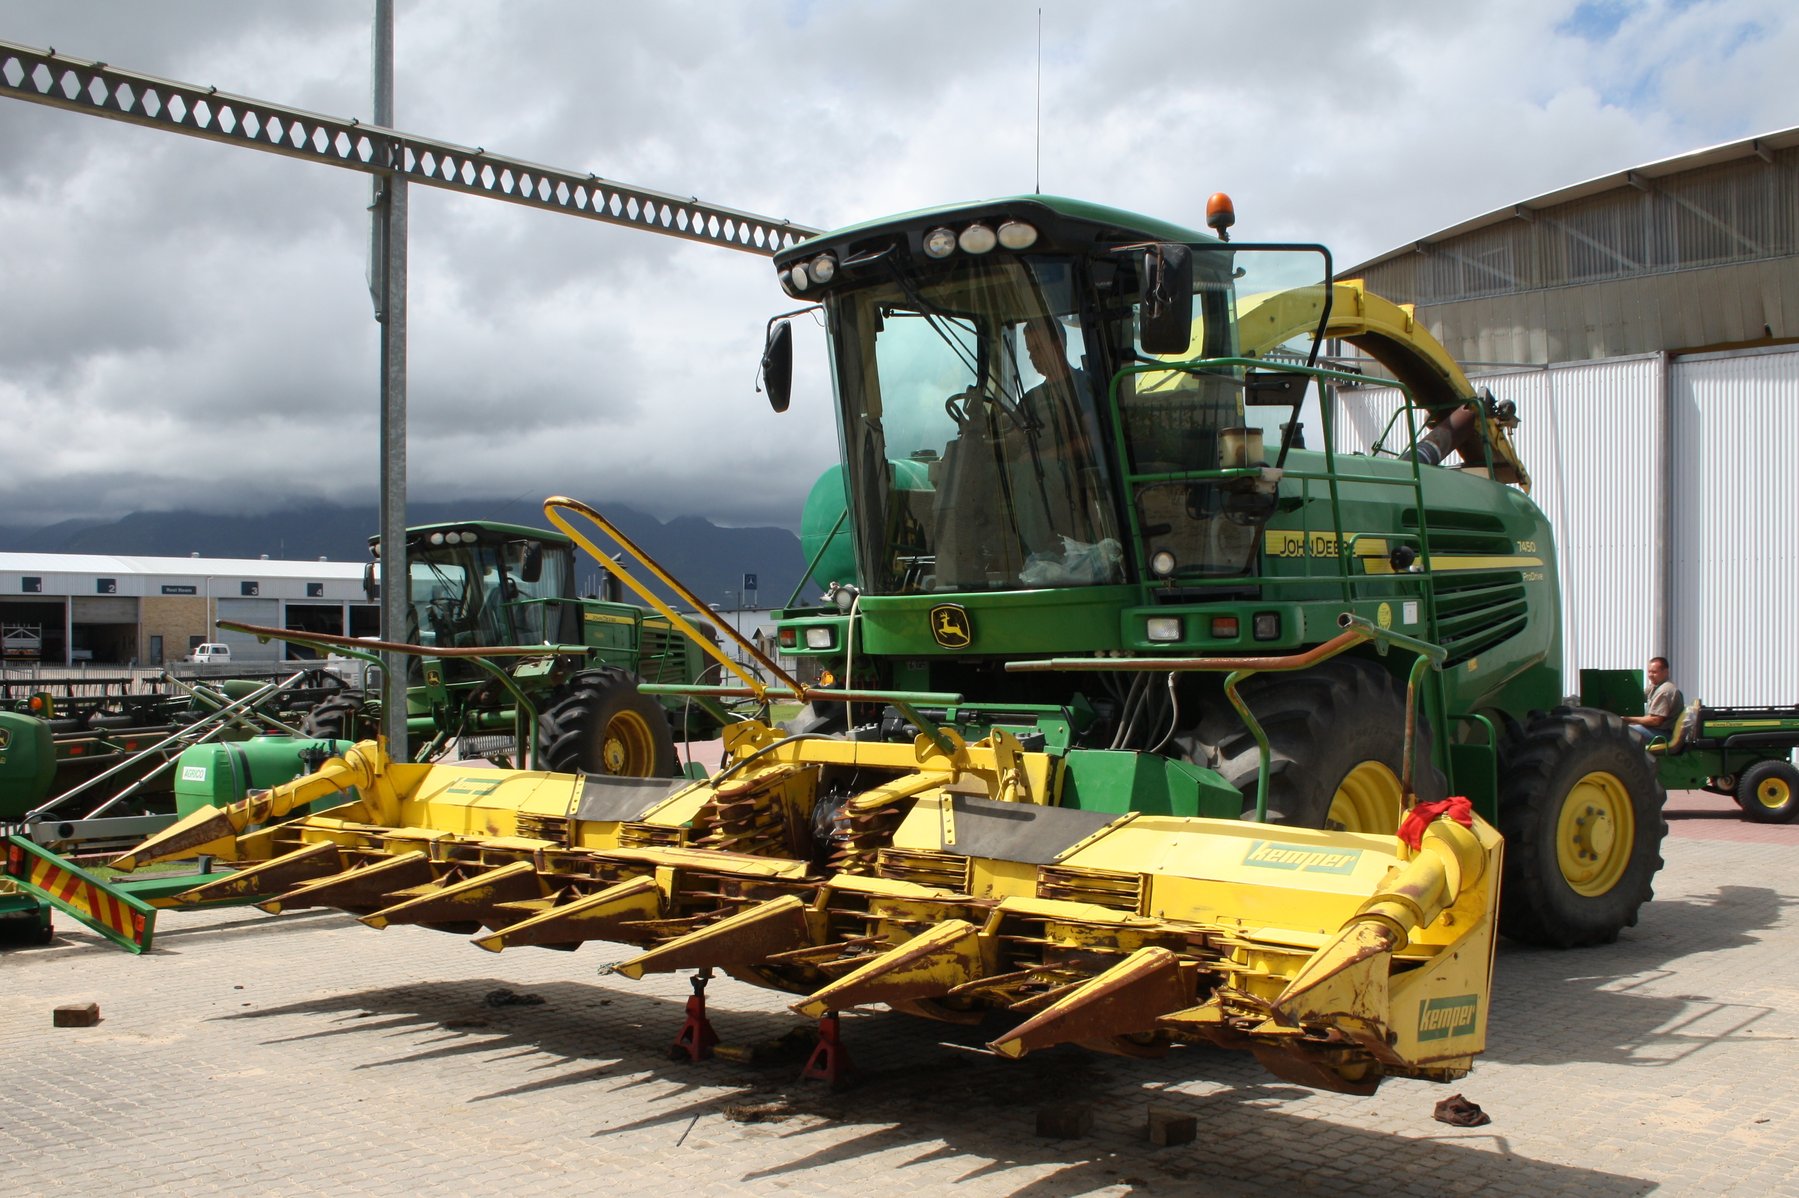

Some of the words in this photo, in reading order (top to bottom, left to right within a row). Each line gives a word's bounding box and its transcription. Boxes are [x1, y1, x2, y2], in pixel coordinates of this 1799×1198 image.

[1517, 541, 1536, 552] 7450
[1523, 572, 1543, 581] ProDrive
[35, 583, 41, 592] 1
[108, 584, 115, 593] 2
[251, 587, 257, 595] 3
[316, 588, 323, 596] 4
[1247, 840, 1357, 872] kemper
[1420, 998, 1475, 1038] kemper
